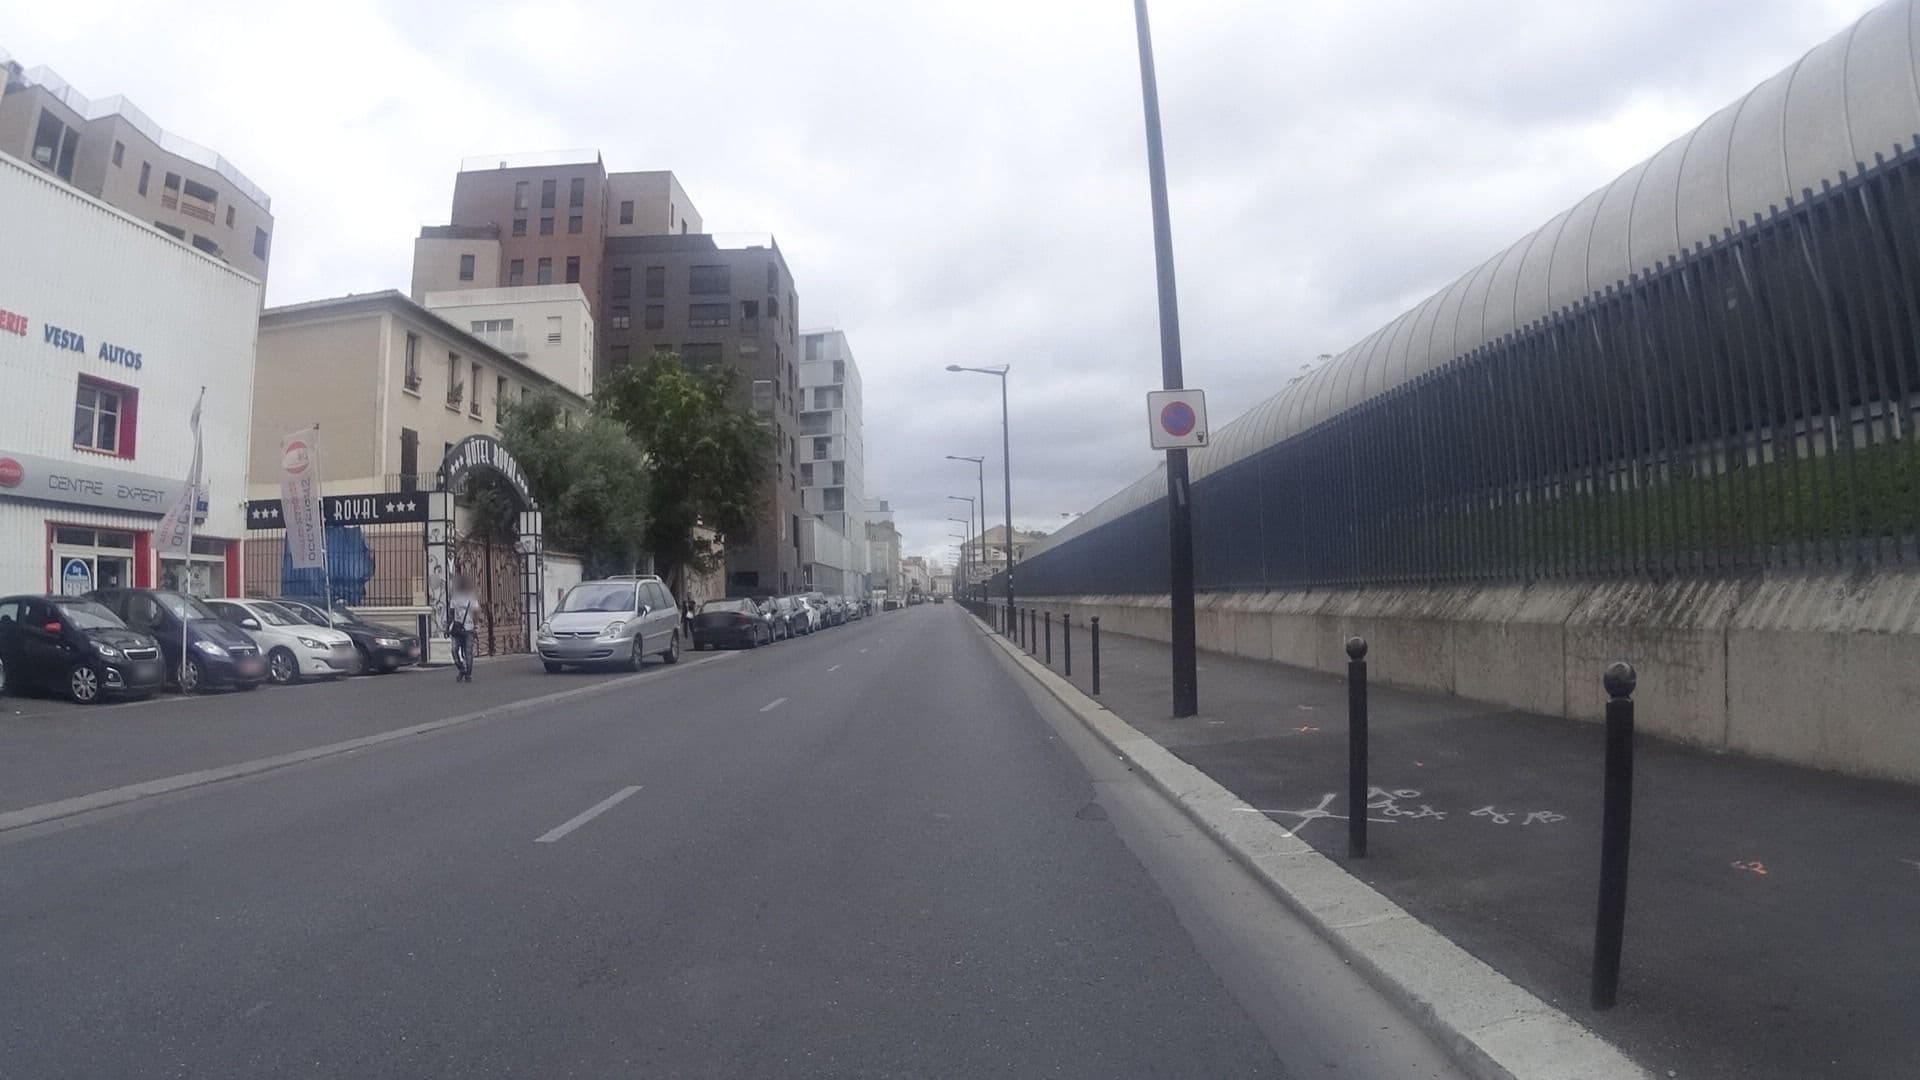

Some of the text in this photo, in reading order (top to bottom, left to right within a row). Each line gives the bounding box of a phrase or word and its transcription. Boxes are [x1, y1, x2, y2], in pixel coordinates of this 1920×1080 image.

[44, 323, 85, 353] VESTA
[98, 341, 142, 371] AUTOS
[464, 437, 517, 484] HÔTEL ROYAL
[49, 474, 165, 503] CENTRE EXPERT
[333, 497, 379, 521] ROYAL
